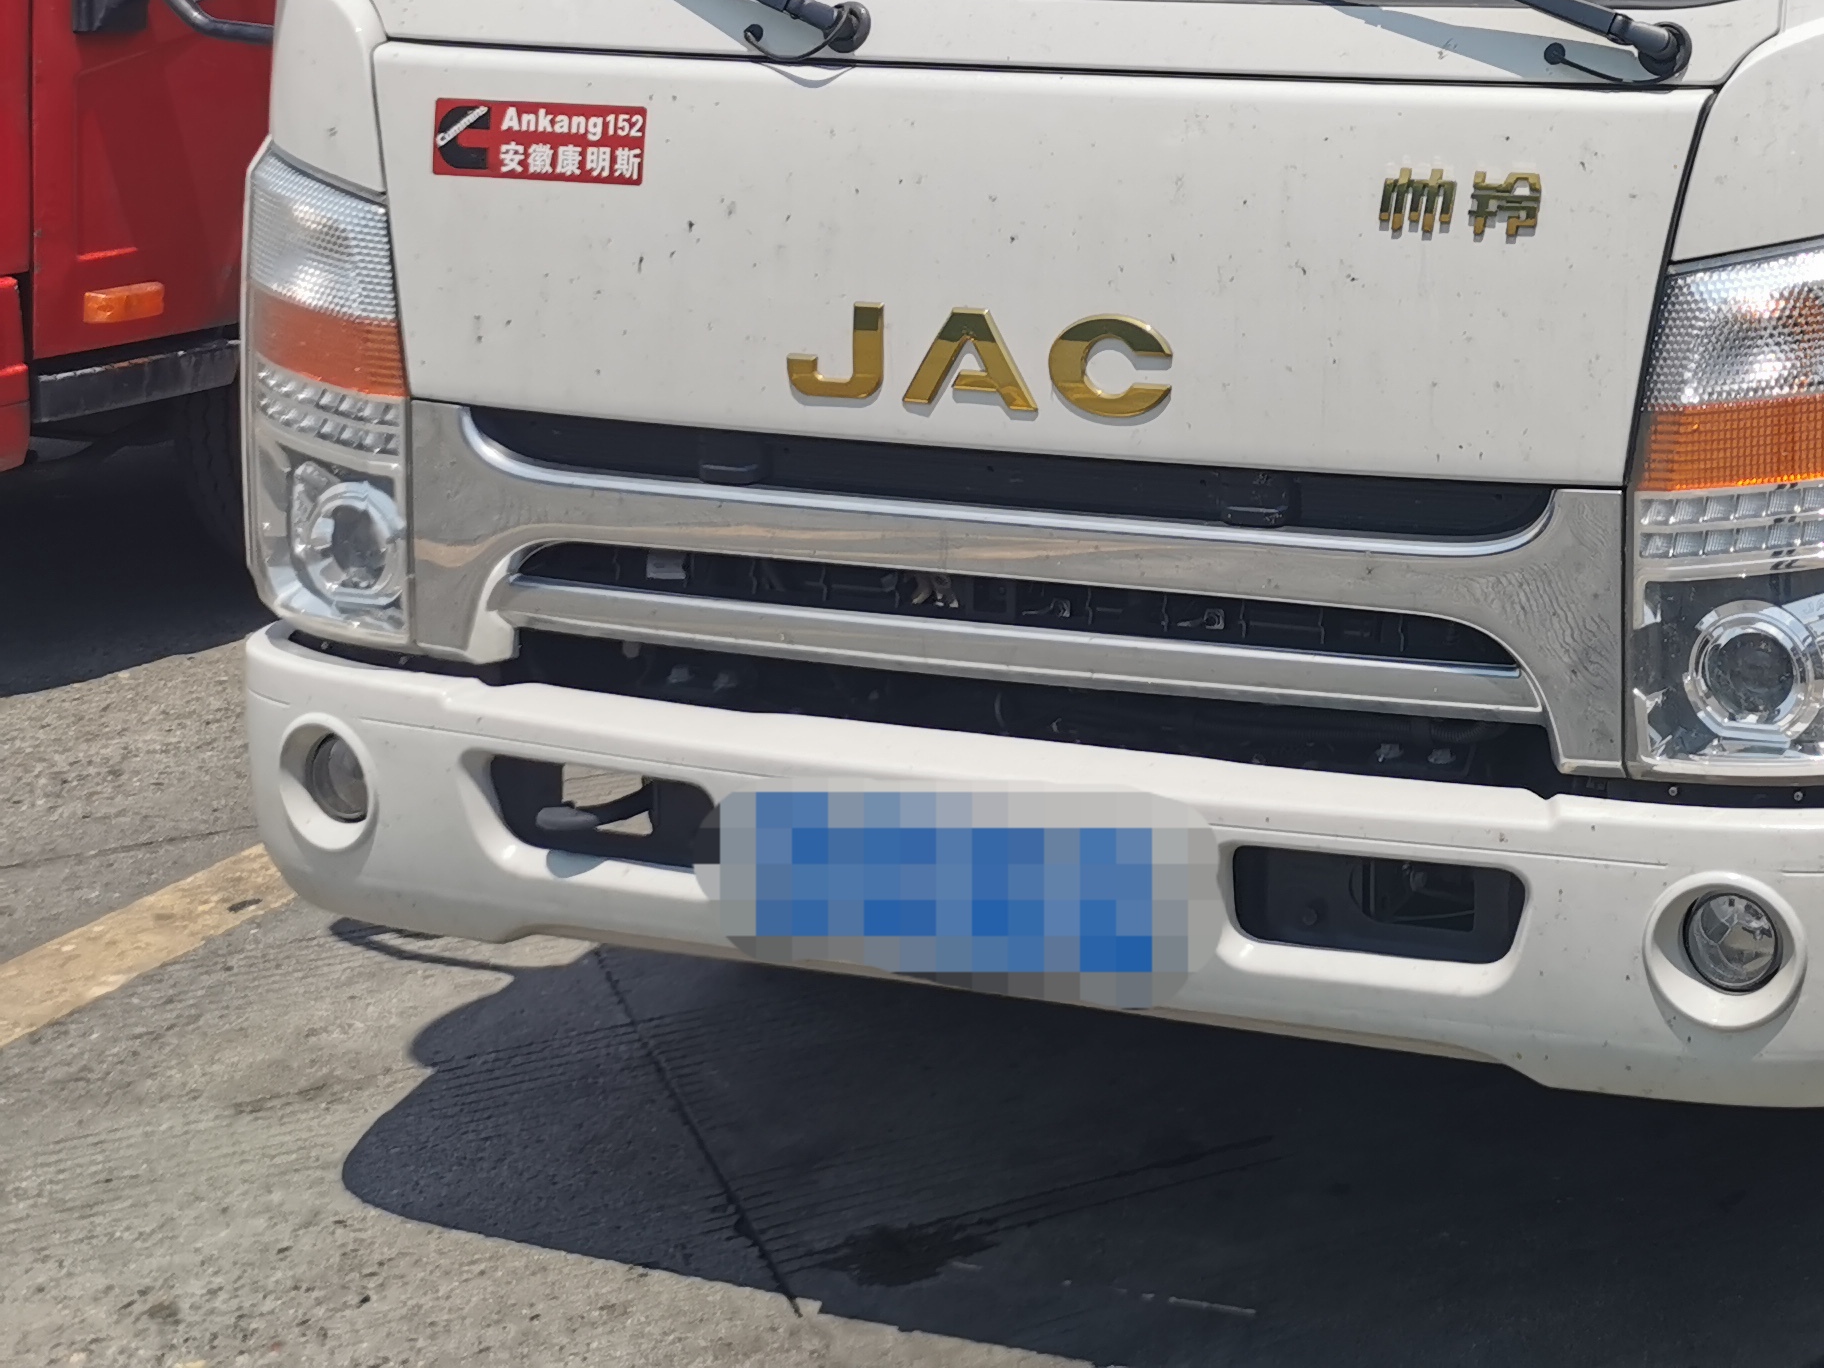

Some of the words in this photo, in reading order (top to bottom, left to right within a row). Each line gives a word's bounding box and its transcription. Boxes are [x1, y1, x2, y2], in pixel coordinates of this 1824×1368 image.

[436, 106, 489, 147] Cummins
[501, 107, 644, 141] Ankang152
[500, 141, 642, 180] 安徽康明斯
[787, 301, 1173, 418] JAC
